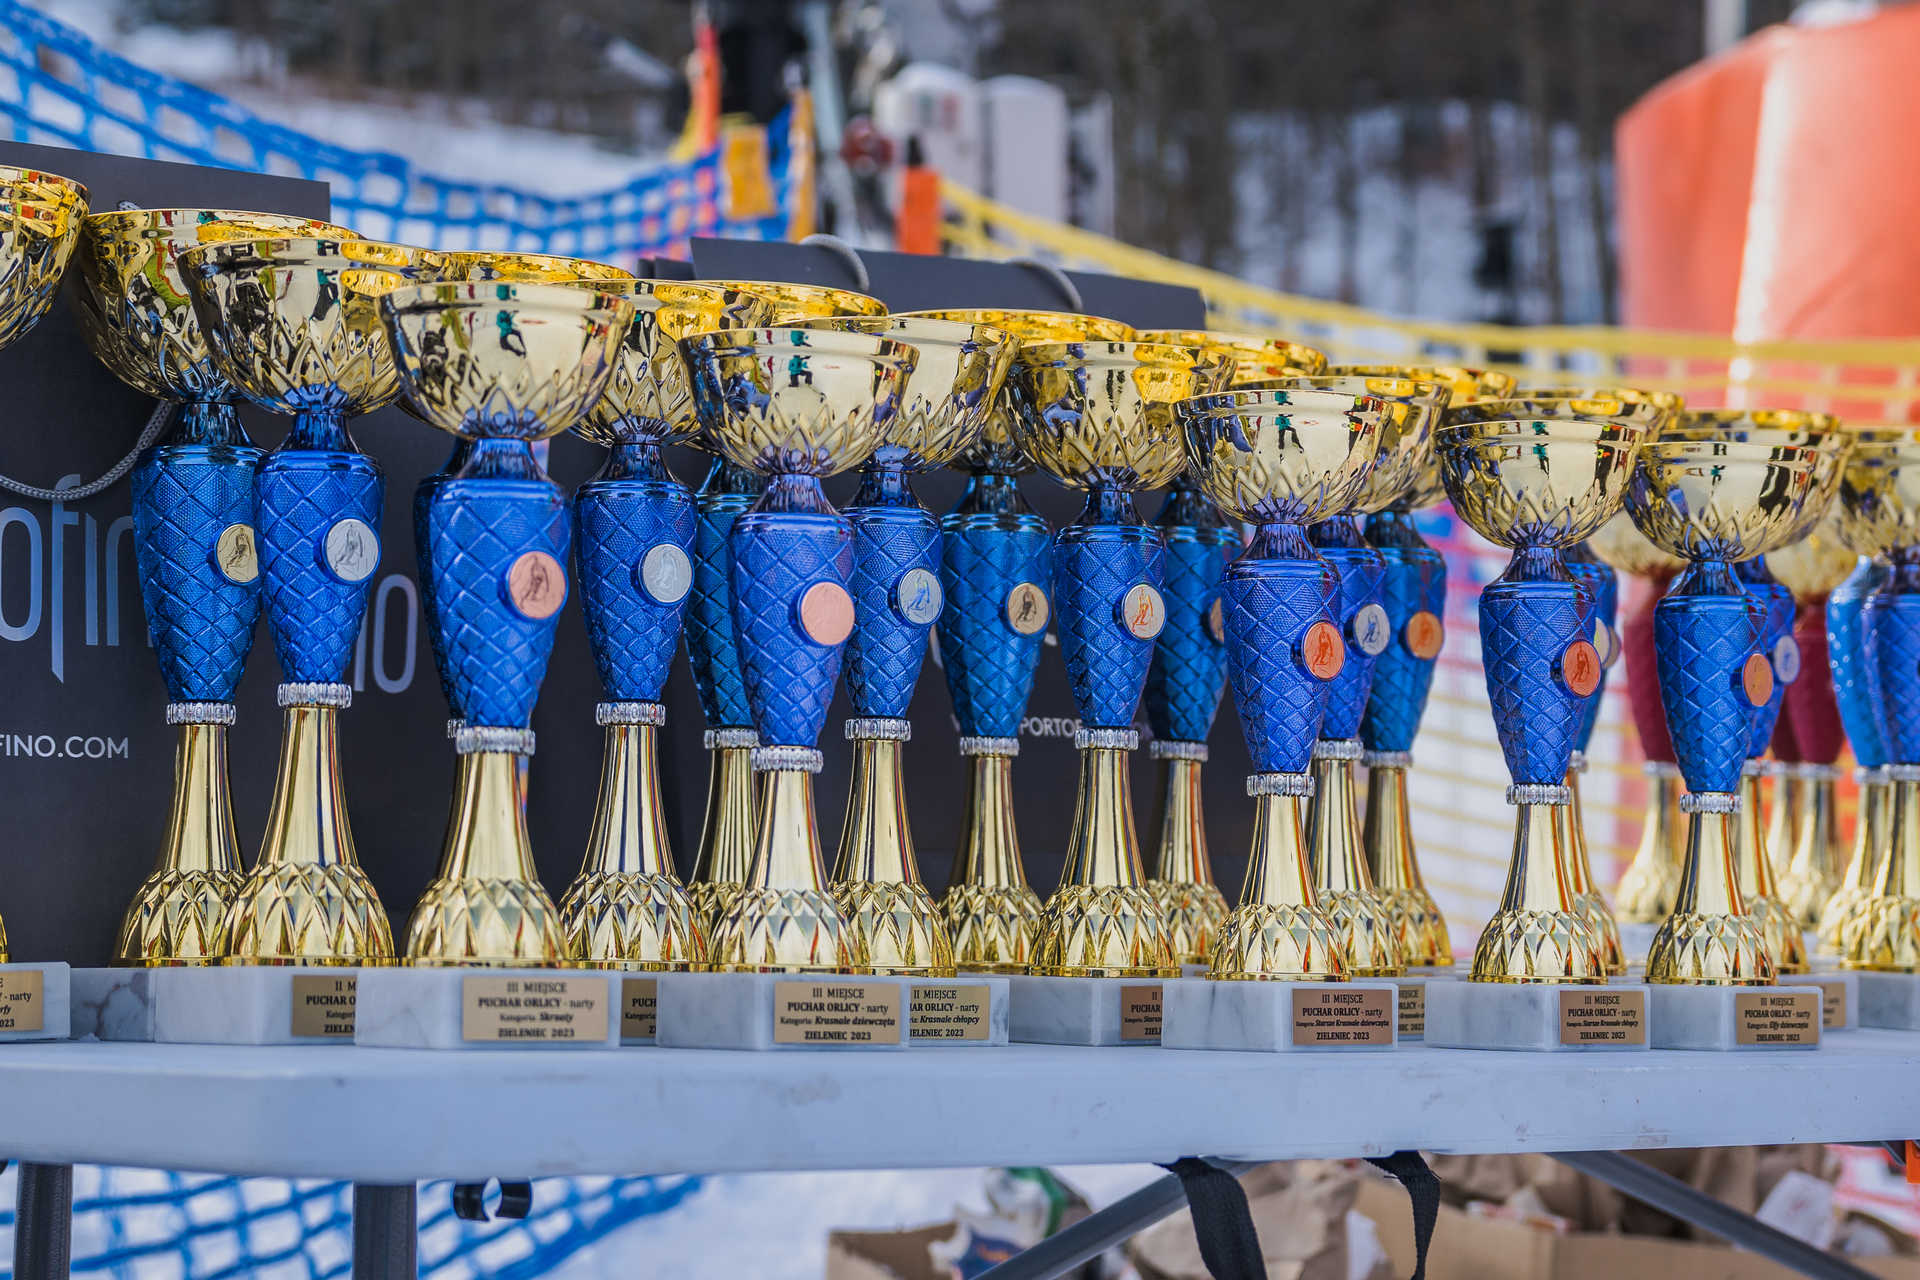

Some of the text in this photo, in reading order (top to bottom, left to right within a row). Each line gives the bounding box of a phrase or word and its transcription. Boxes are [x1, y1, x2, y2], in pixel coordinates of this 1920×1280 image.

[335, 980, 343, 992] II
[507, 982, 567, 995] III MIEJSCE
[9, 992, 32, 1003] narty
[812, 987, 865, 1000] III MIEJSCE
[913, 989, 957, 1001] II MIEJSCE
[1151, 991, 1158, 1001] II
[306, 995, 346, 1005] PUCHAR
[478, 997, 521, 1008] PUCHAR
[523, 997, 561, 1008] ORLICY
[569, 999, 595, 1011] narty
[1321, 994, 1364, 1006] III MIEJSCE
[1584, 995, 1621, 1007] III MIEJSCE
[1769, 997, 1796, 1008] MIEJSCE
[787, 1001, 825, 1012] PUCHAR
[827, 1001, 860, 1013] ORLICY
[867, 1004, 889, 1015] narty
[925, 1002, 954, 1012] ORLICY
[960, 1004, 980, 1014] narty
[1130, 1003, 1161, 1013] PUCHAR
[1302, 1007, 1333, 1017] PUCHAR
[1333, 1007, 1360, 1017] ORLICY
[1365, 1008, 1383, 1018] narty
[1567, 1008, 1594, 1017] PUCHAR
[1594, 1008, 1617, 1017] ORLICY
[1621, 1009, 1637, 1019] narty
[1744, 1009, 1770, 1018] PUCHAR
[1769, 1009, 1793, 1018] ORLICY
[920, 1015, 952, 1024] Krasnale
[953, 1015, 980, 1025] chłopcy
[498, 1028, 575, 1038] ZIELENIEC 2023
[804, 1031, 872, 1041] ZIELENIEC 2023
[945, 1028, 965, 1037] 2023
[1316, 1031, 1370, 1041] ZIELENIEC 2023
[1579, 1031, 1626, 1040] ZIELENIEC 2023
[1756, 1033, 1801, 1042] ZIELENIEC 2023
